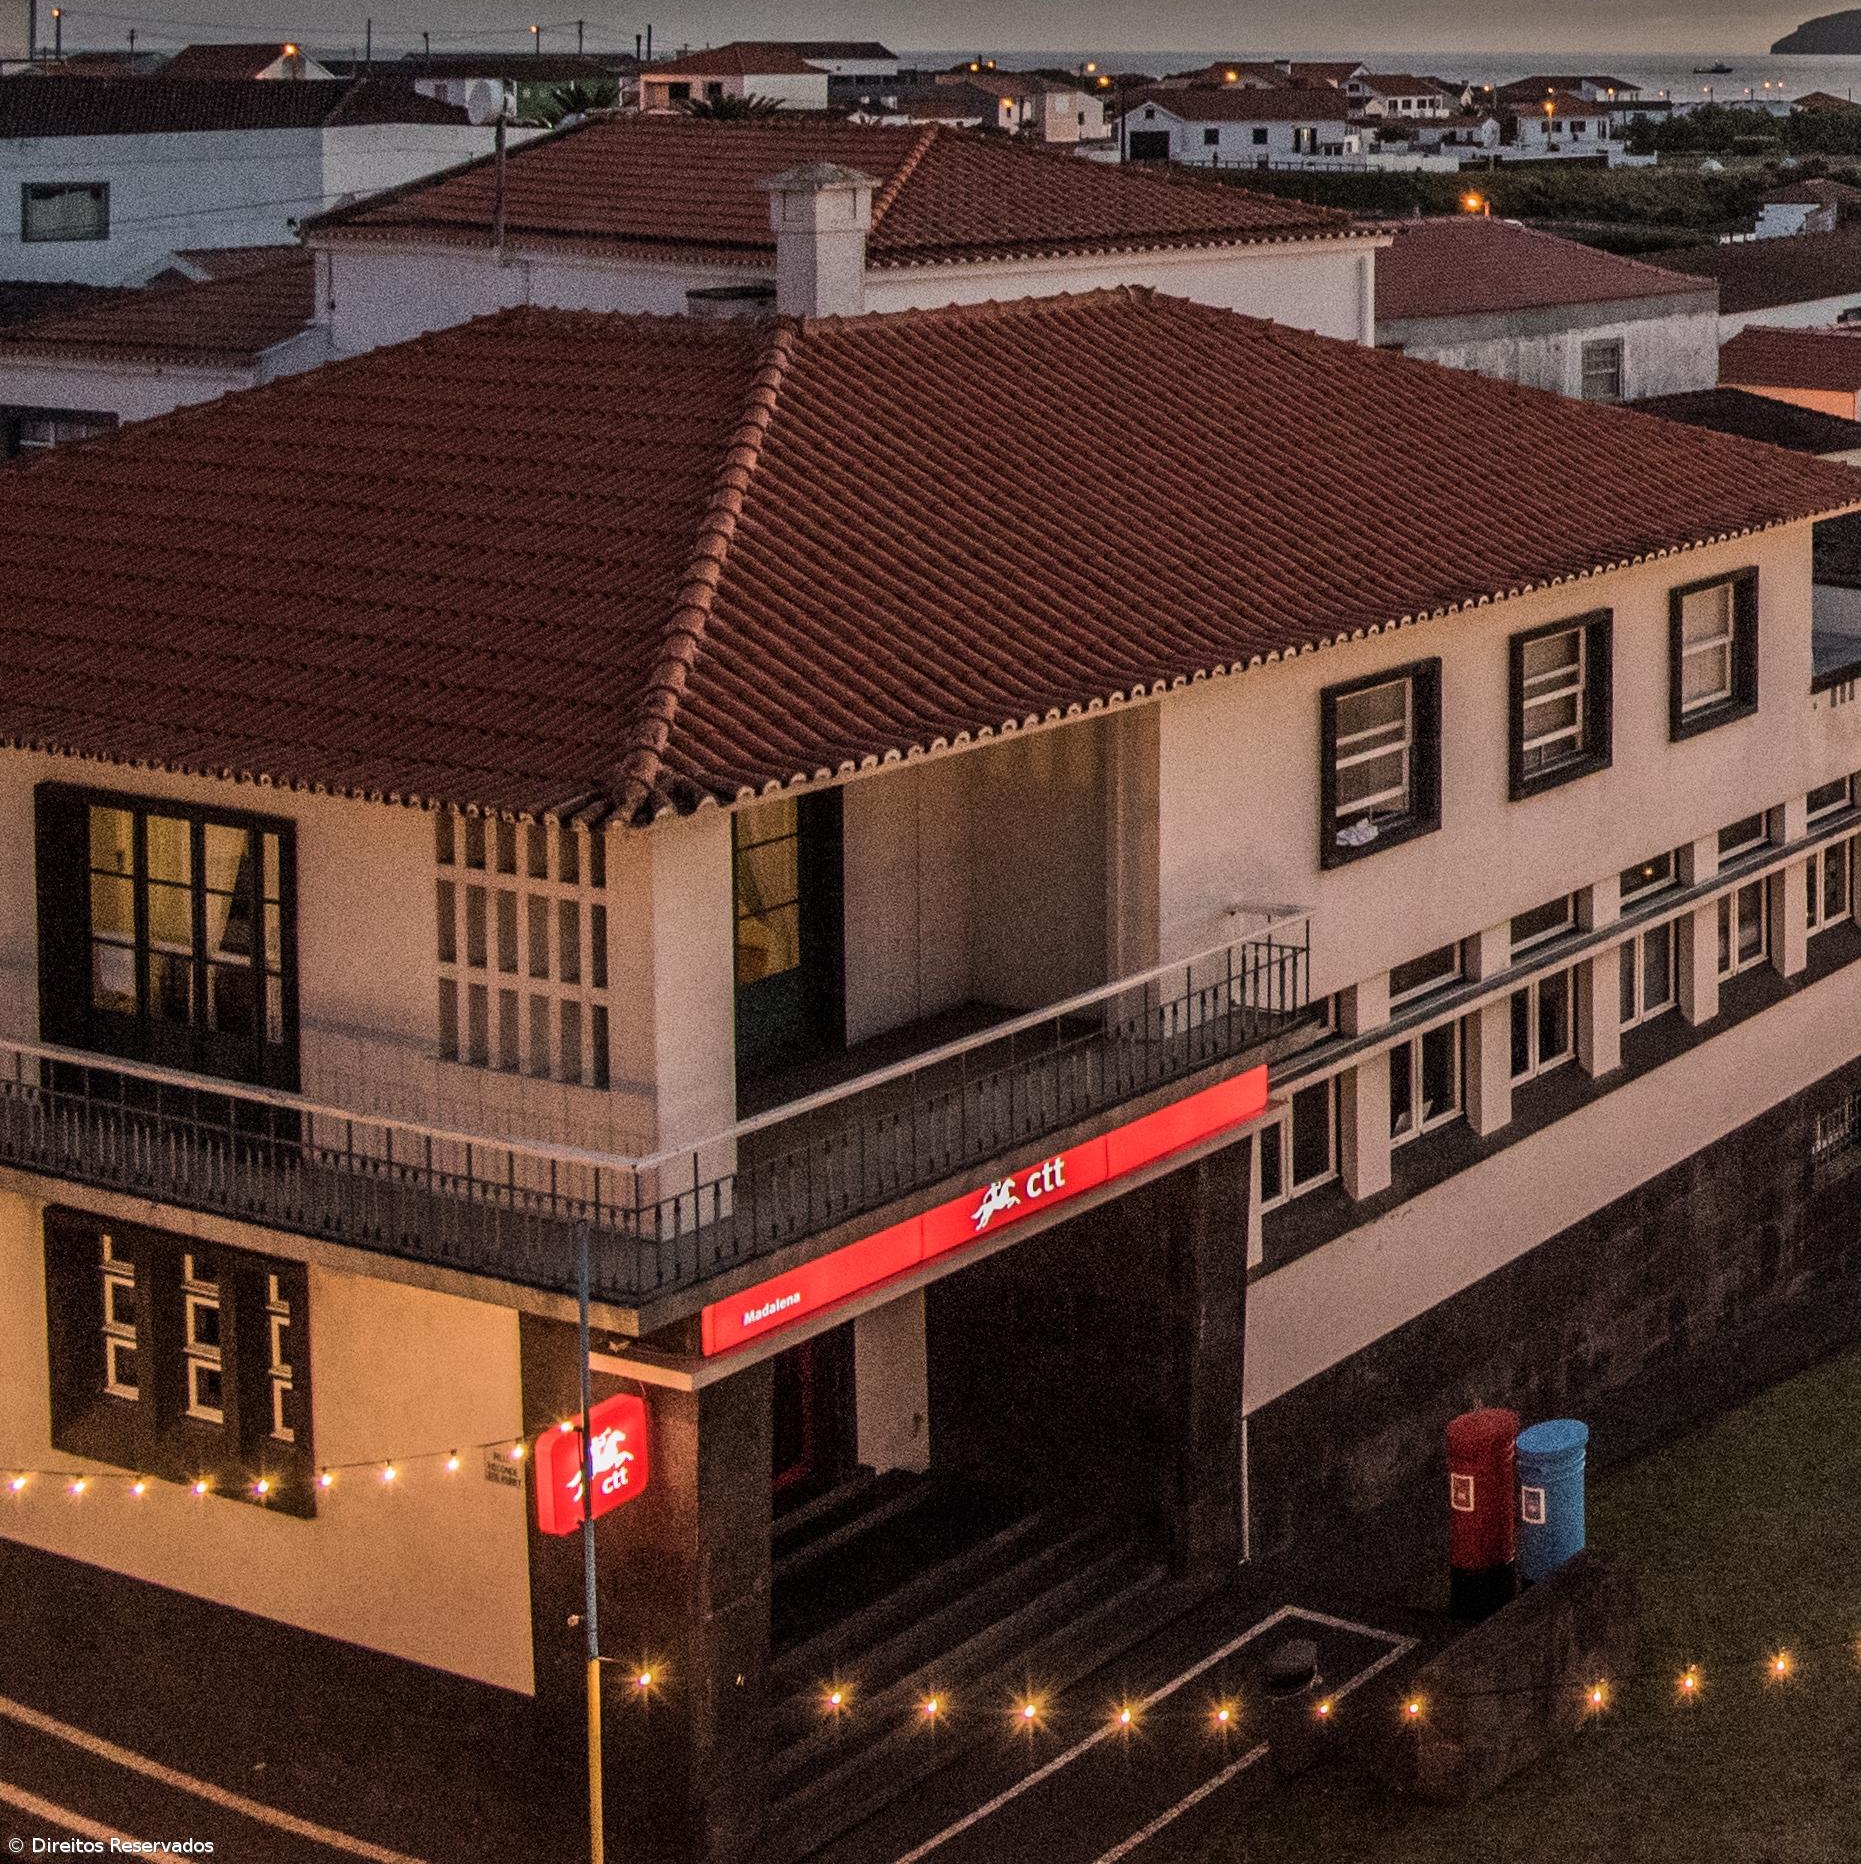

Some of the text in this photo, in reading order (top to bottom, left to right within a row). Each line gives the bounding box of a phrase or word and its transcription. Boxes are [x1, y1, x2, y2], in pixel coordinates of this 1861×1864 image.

[1026, 1157, 1066, 1198] ctt
[743, 1292, 801, 1326] Madalena
[602, 1467, 629, 1494] ctt
